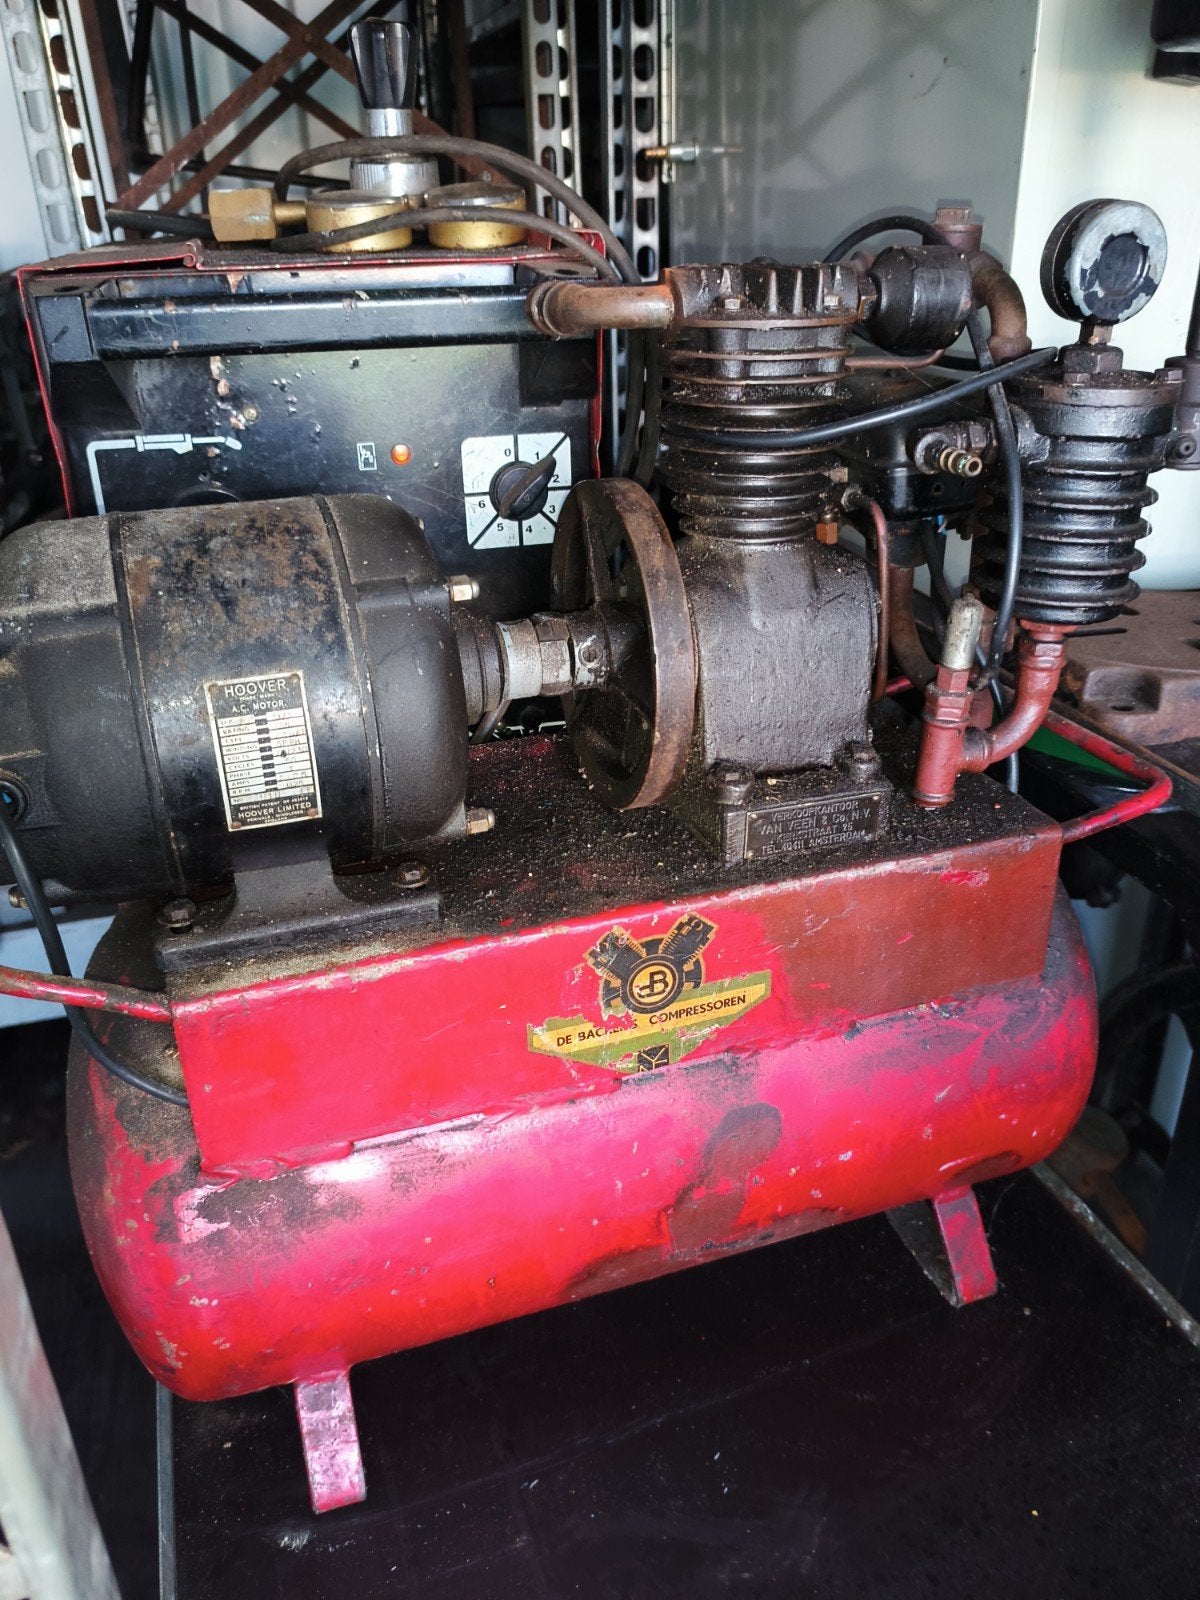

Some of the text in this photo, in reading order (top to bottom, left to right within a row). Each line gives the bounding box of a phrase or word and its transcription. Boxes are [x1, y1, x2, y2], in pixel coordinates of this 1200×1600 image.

[504, 448, 512, 457] 0
[534, 451, 540, 461] 1
[552, 474, 560, 483] 2
[478, 499, 486, 508] 6
[549, 505, 556, 514] 3
[497, 523, 504, 532] 5
[525, 525, 533, 534] 4
[238, 801, 312, 819] HOOVER LIMITED
[760, 821, 783, 836] VAN
[788, 816, 817, 831] VEEN
[808, 830, 866, 847] AMSTERDAM
[557, 1034, 573, 1047] DE
[648, 994, 747, 1026] COMPRESSOREN
